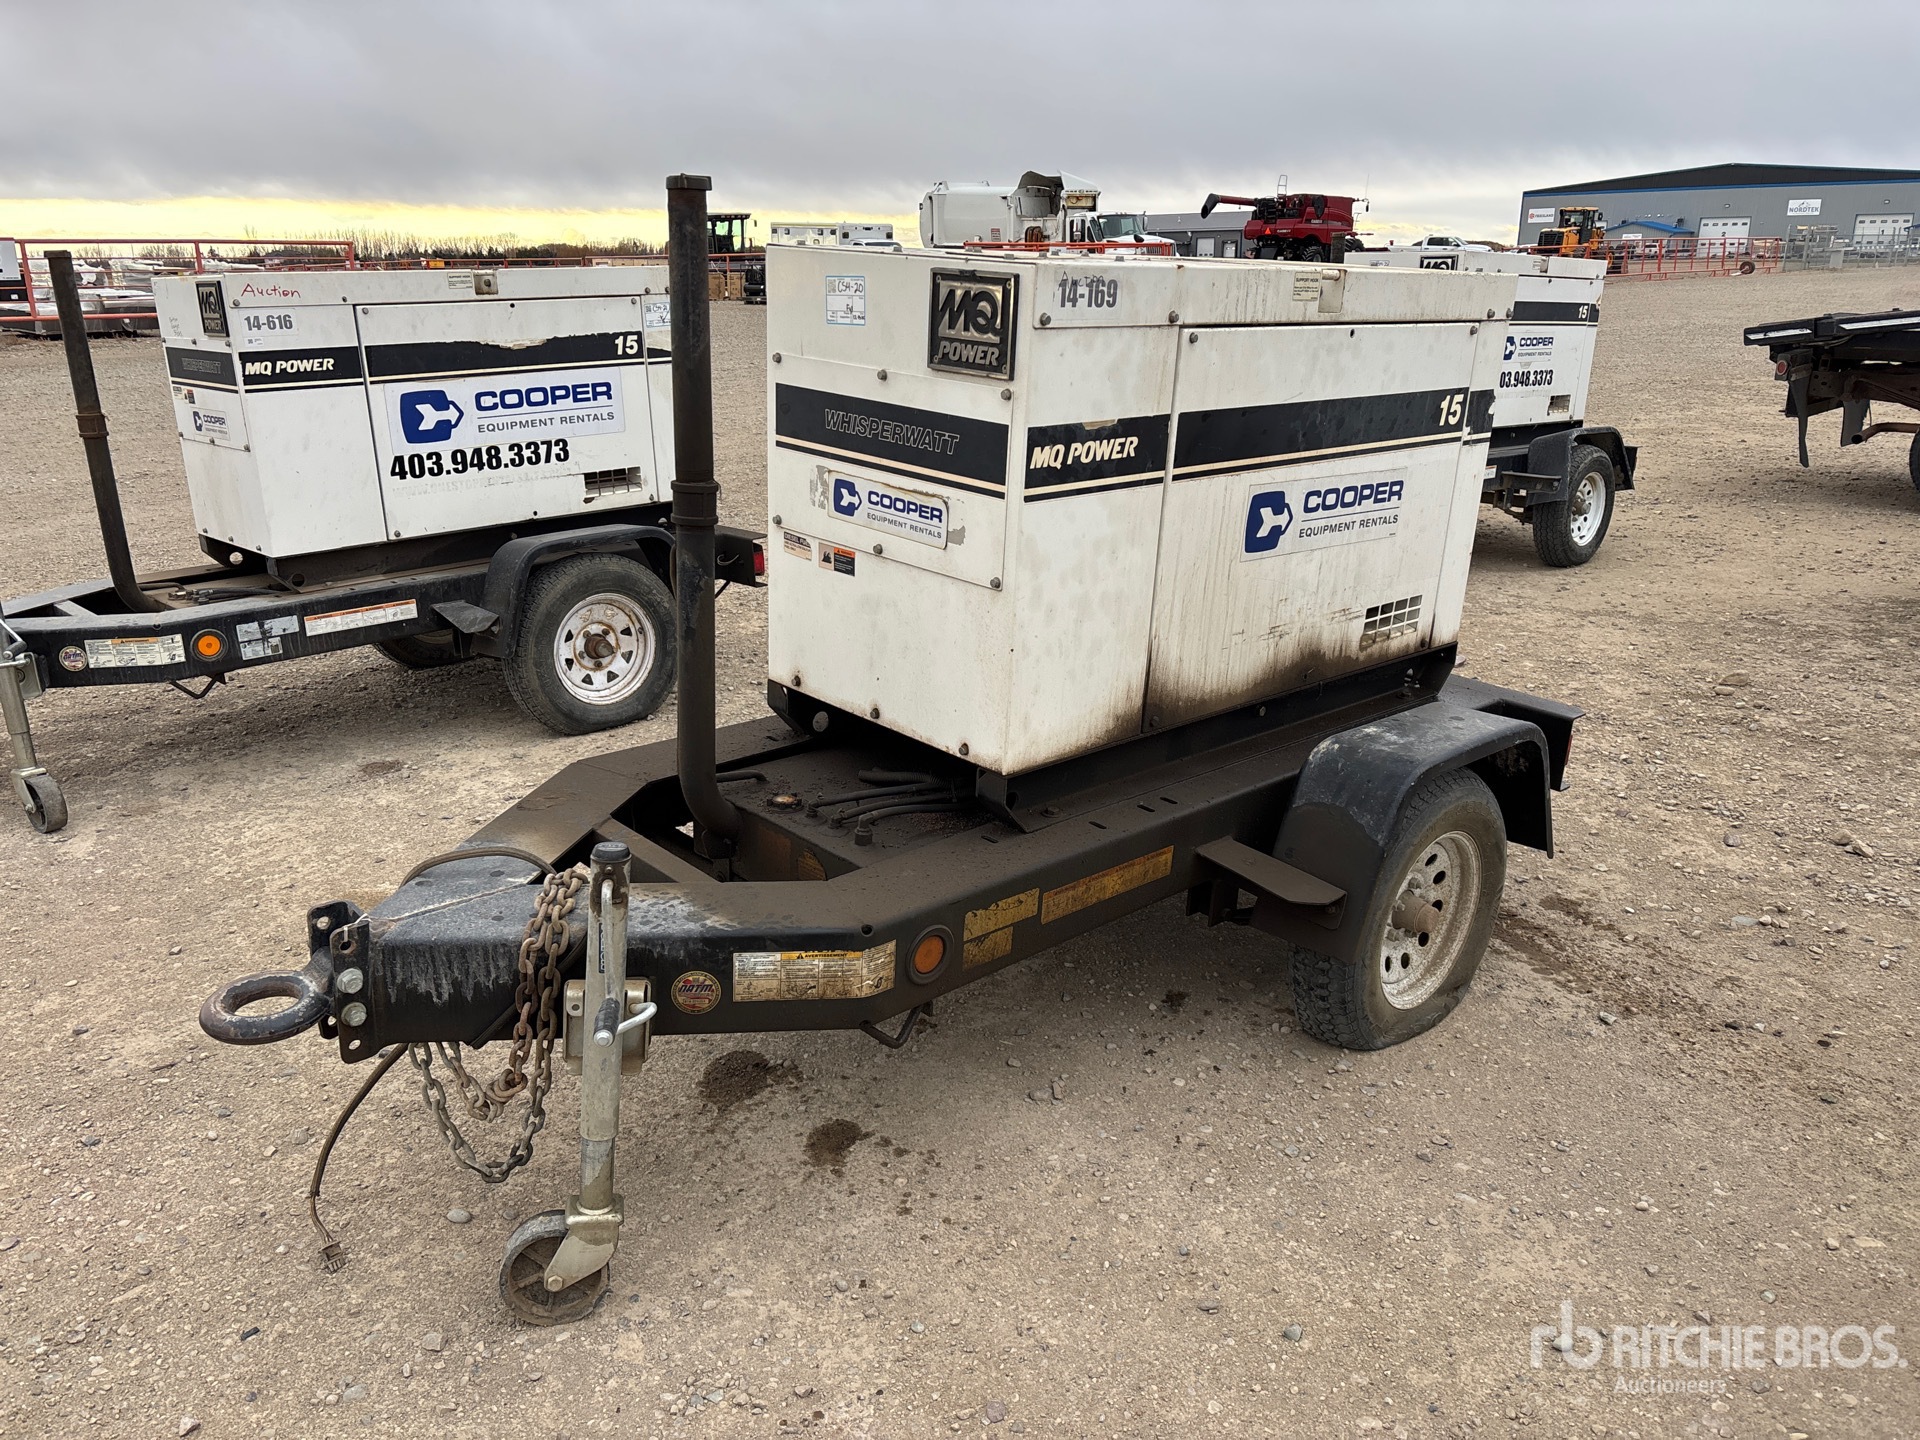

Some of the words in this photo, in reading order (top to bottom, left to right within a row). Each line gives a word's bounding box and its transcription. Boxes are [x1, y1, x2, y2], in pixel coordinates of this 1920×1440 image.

[241, 283, 301, 298] Auction
[1060, 279, 1118, 308] 14-169
[244, 314, 293, 331] 14-616
[940, 288, 1002, 338] MQ
[1578, 305, 1589, 319] 15
[614, 335, 638, 355] 15
[939, 341, 1000, 366] POWER
[1519, 337, 1554, 347] COOPER
[245, 361, 272, 376] MQ
[276, 358, 335, 374] POWER
[475, 381, 613, 411] COOPER
[203, 414, 227, 426] COOPER
[478, 417, 555, 433] EQUIPMENT
[560, 411, 615, 425] RENTALS
[1438, 394, 1464, 426] 15
[825, 409, 960, 455] WHISPERWATT
[390, 438, 570, 480] 403.948.3373
[1030, 444, 1065, 470] MQ
[1067, 436, 1139, 465] POWER
[868, 490, 943, 523] COOPER
[1303, 480, 1404, 513] COOPER
[867, 512, 908, 530] EQUIPMENT
[909, 524, 942, 539] RENTALS
[1299, 521, 1357, 538] EQUIPMENT
[1358, 514, 1399, 529] RENTALS
